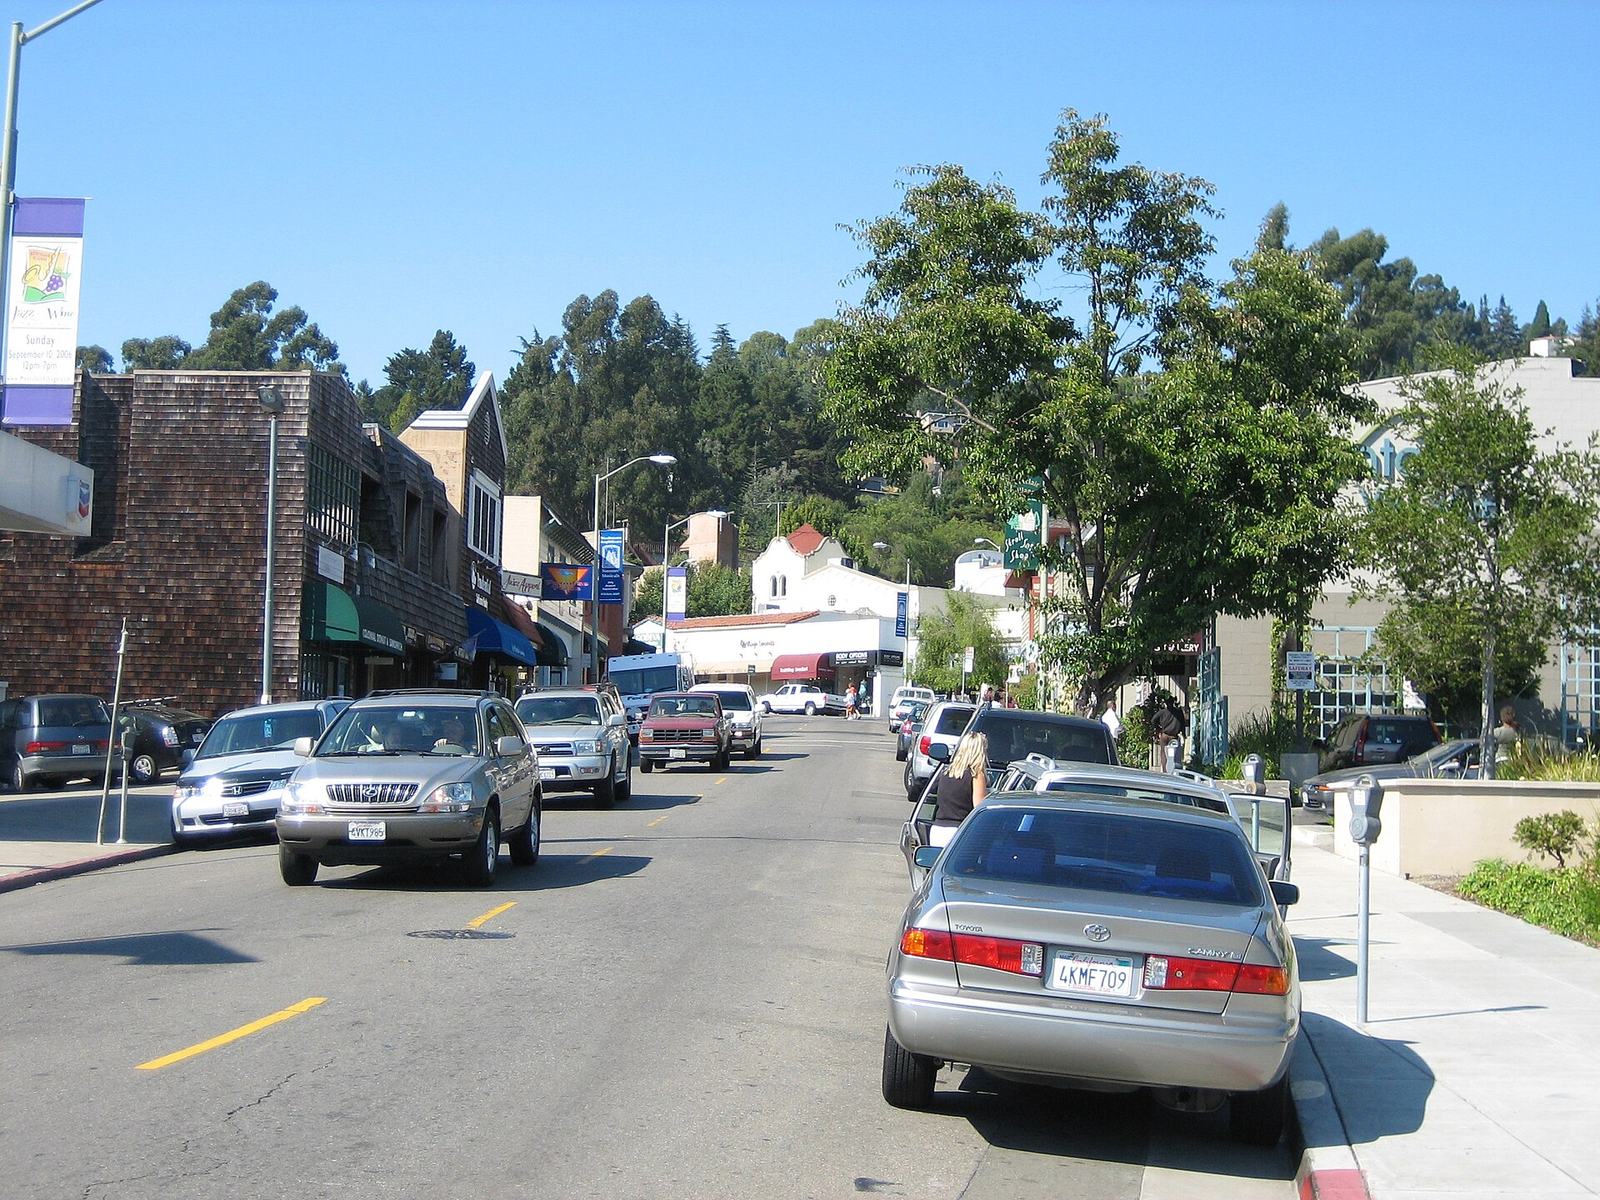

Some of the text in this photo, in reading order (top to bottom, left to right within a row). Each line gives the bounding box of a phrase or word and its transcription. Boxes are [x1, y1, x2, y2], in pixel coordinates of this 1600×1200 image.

[26, 334, 55, 347] Sunday
[1005, 531, 1024, 552] Stroll
[1010, 550, 1029, 562] Shop
[955, 924, 984, 933] TOYOTA
[1187, 947, 1229, 958] CAMRY
[1071, 954, 1114, 967] California
[1059, 965, 1127, 990] 4KMF709
